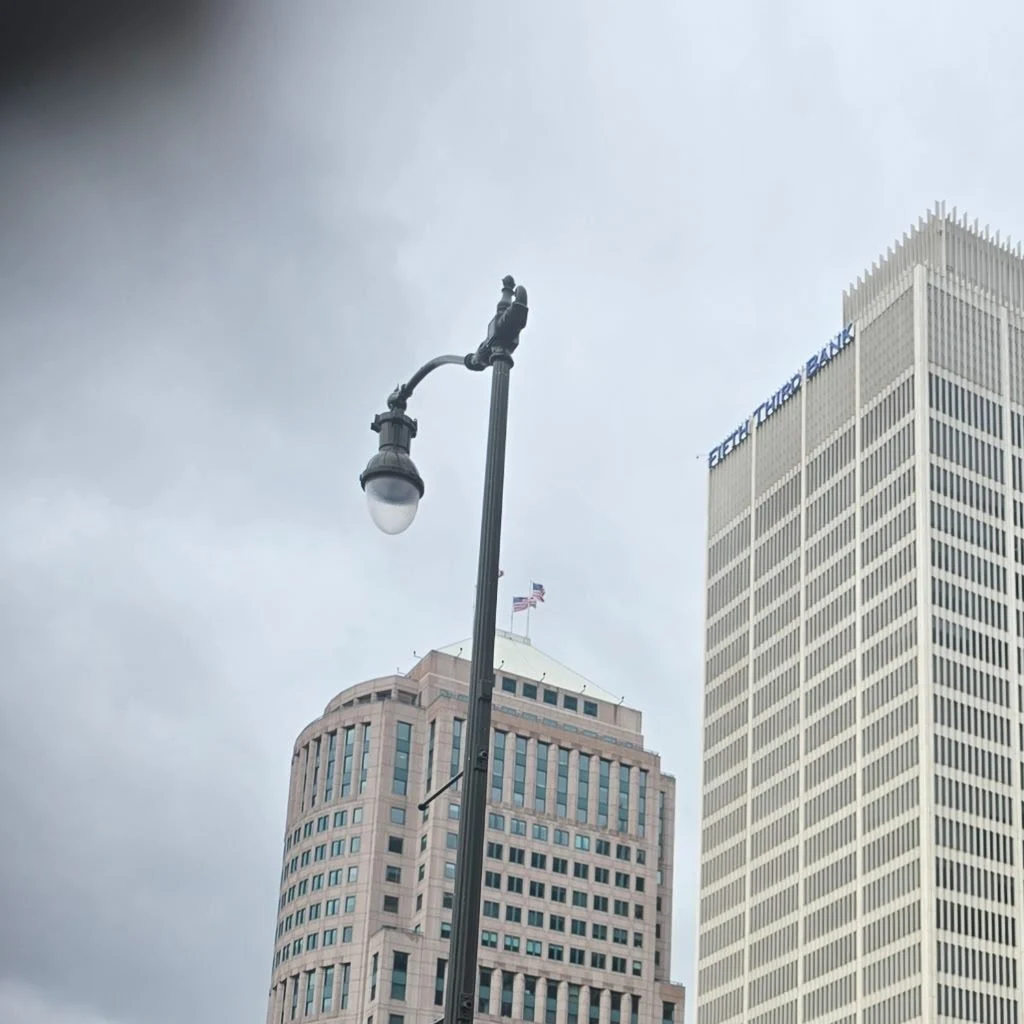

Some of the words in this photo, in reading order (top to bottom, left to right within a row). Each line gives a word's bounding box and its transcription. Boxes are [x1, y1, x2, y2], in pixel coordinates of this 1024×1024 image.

[708, 419, 751, 468] FIFTH
[753, 373, 802, 427] THIRD
[806, 323, 854, 378] BANK
